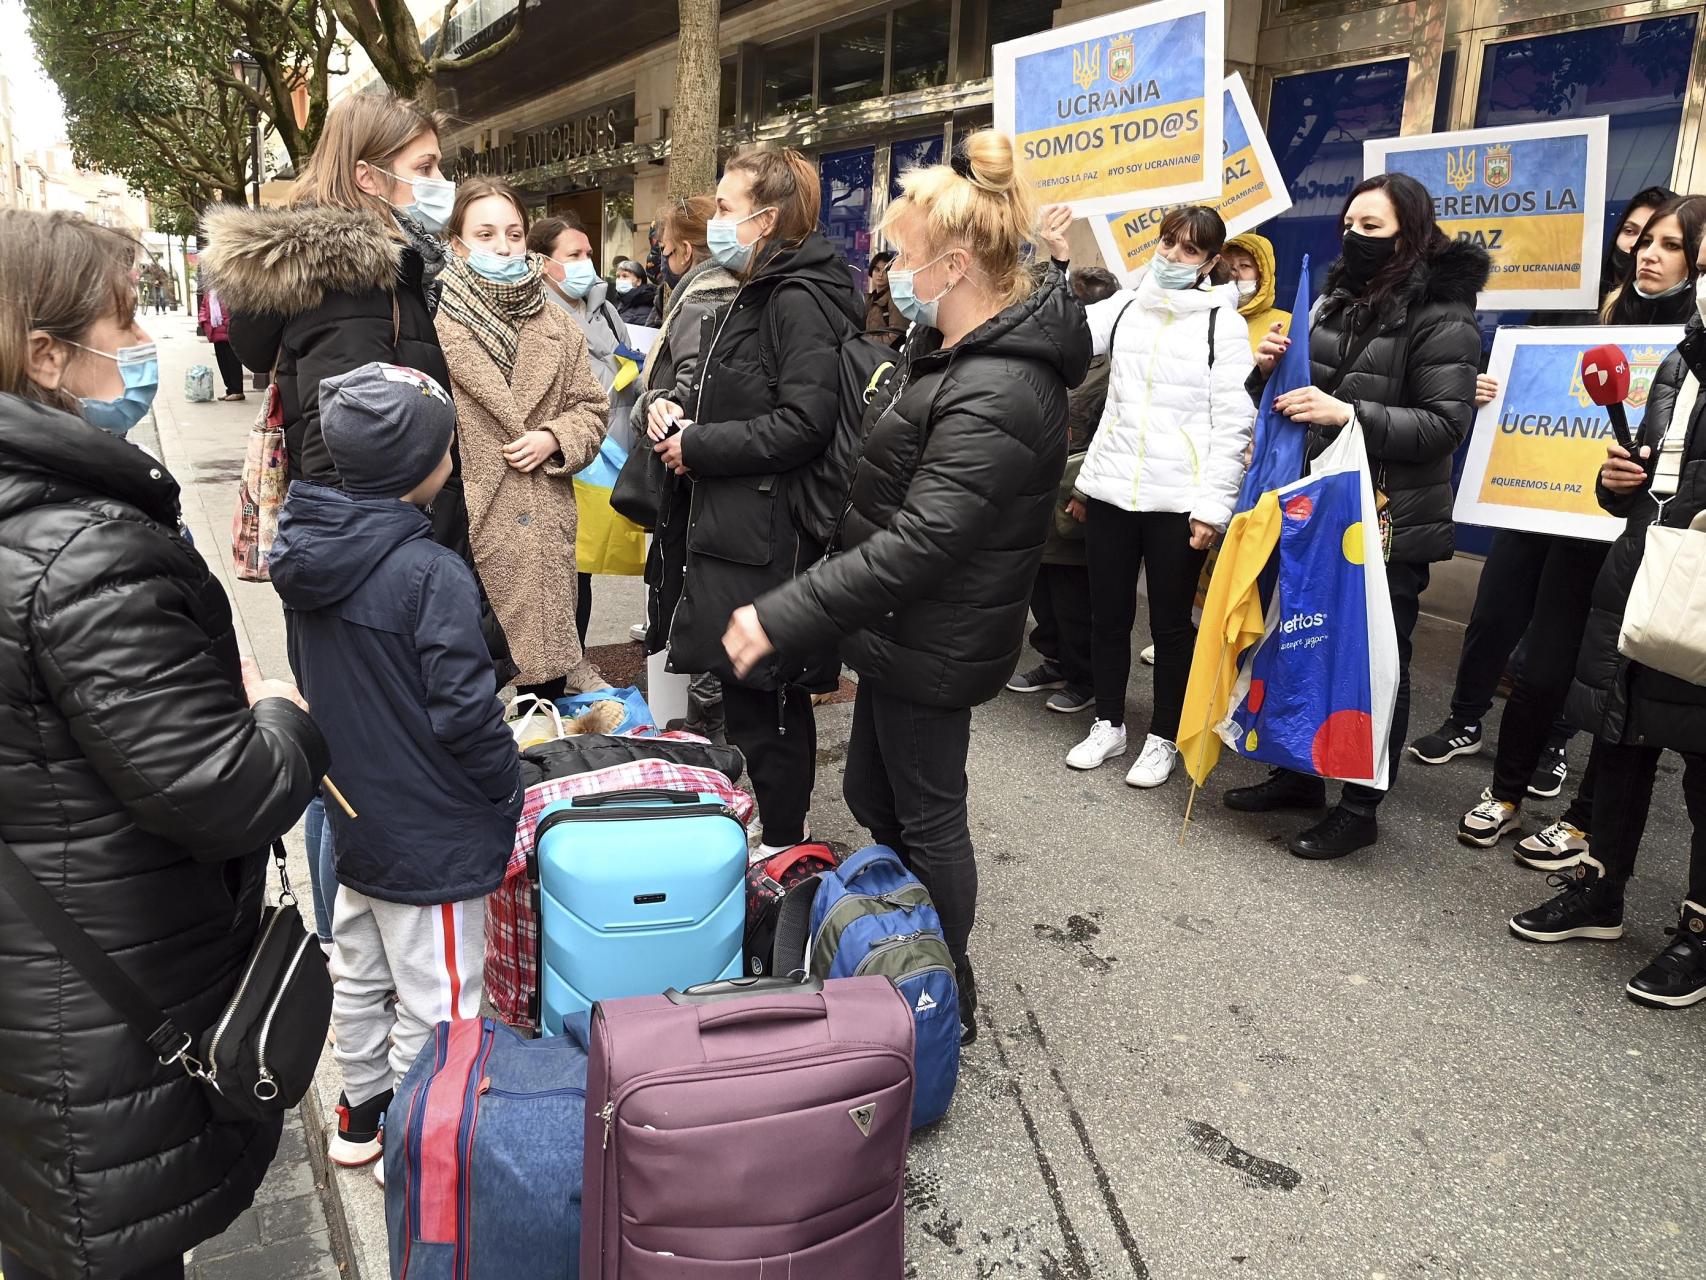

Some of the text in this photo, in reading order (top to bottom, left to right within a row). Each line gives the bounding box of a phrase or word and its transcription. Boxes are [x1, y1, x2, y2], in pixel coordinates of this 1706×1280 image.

[1058, 79, 1161, 119] UCRANIA
[1024, 109, 1199, 160] SOMOS TOD@S
[1107, 152, 1201, 177] #YO SOY UCRANIAN@
[1221, 158, 1252, 186] AZ
[1034, 174, 1070, 189] EREMOS
[1433, 189, 1578, 217] EREMOS LA
[1503, 264, 1520, 273] SOY
[1522, 263, 1580, 273] UCRANIAN@
[1490, 477, 1582, 493] #QUEREMOS LA PAZ
